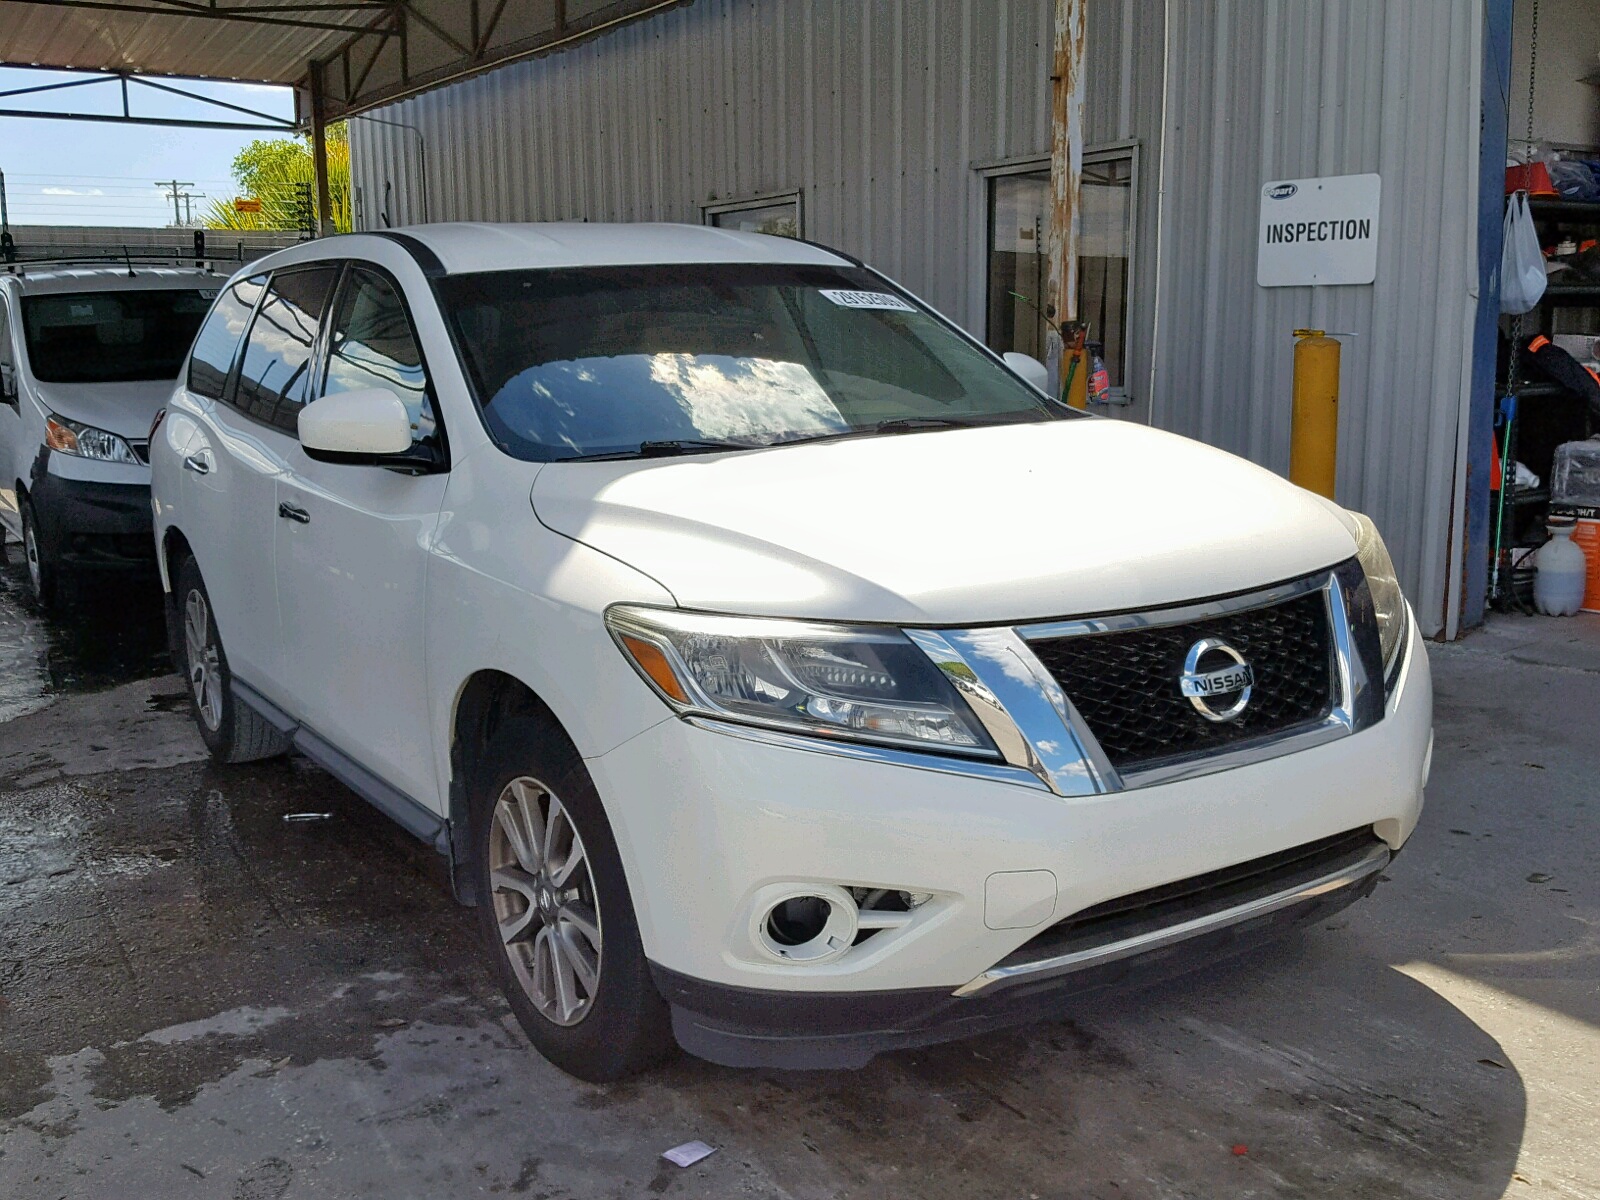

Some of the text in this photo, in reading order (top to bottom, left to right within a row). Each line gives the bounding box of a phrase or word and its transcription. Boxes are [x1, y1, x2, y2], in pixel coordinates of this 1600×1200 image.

[1263, 186, 1294, 198] Copart
[1266, 218, 1370, 244] INSPECTION
[1193, 670, 1253, 692] NISSAN
